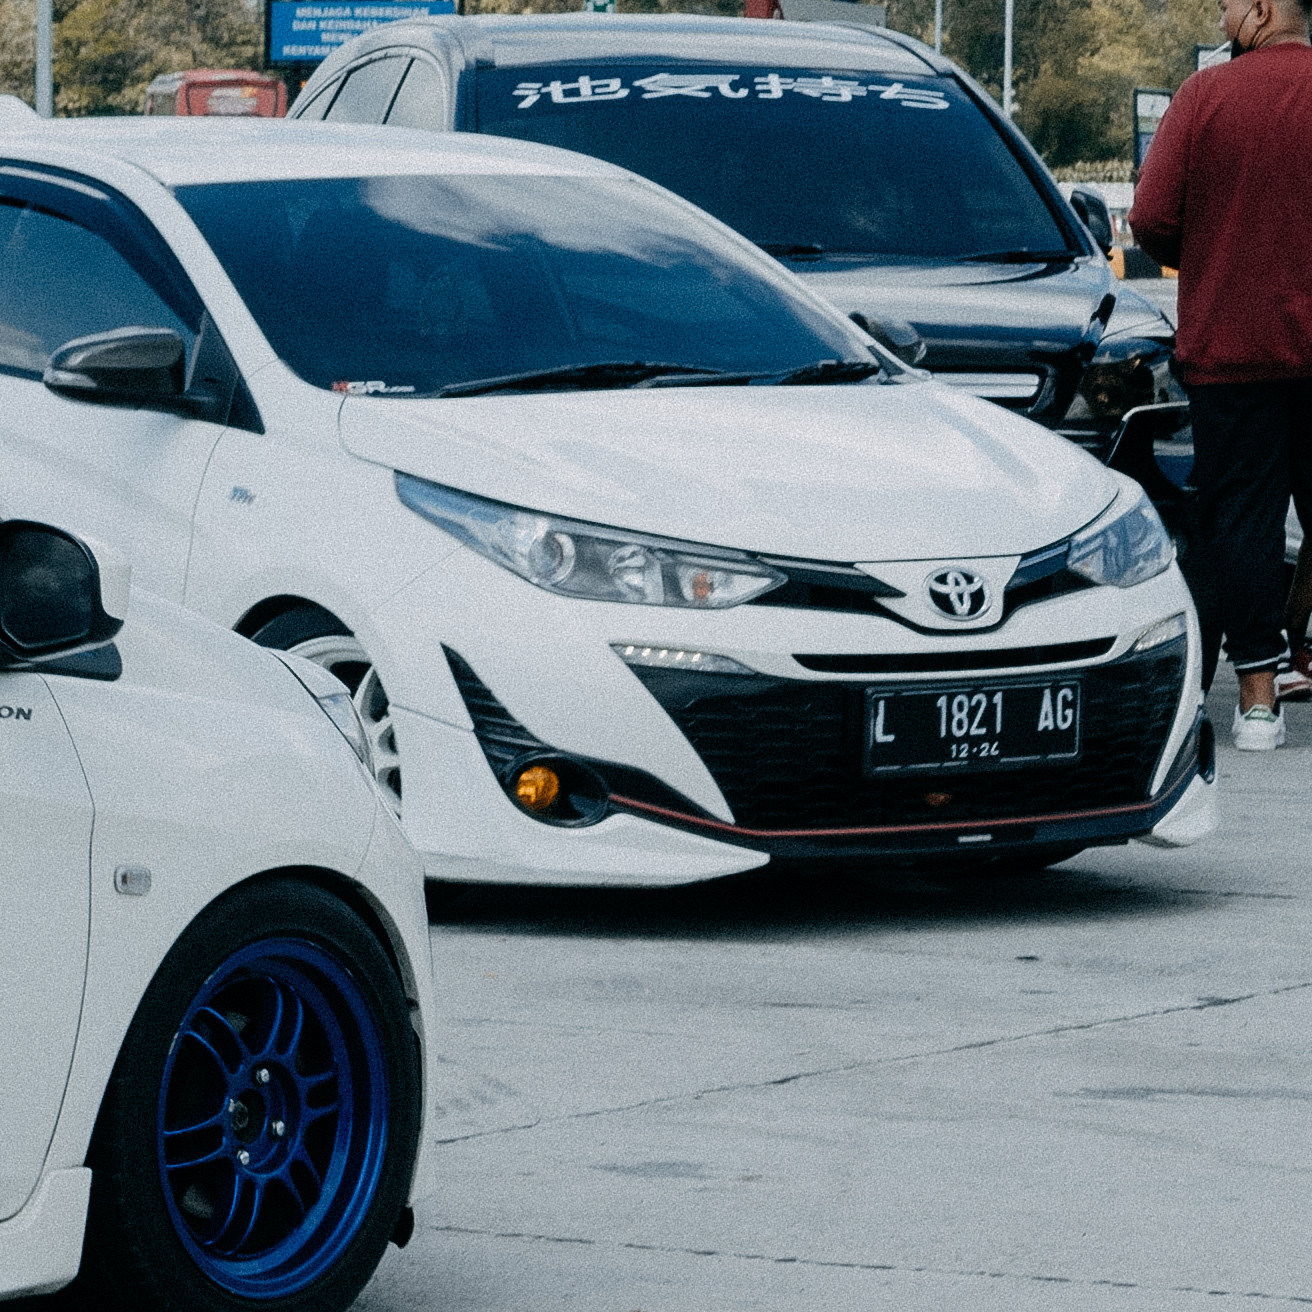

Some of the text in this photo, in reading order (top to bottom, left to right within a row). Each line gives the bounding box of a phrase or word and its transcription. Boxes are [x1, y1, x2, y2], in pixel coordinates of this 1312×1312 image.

[0, 705, 32, 720] ON
[875, 688, 1074, 743] L 1821 AG
